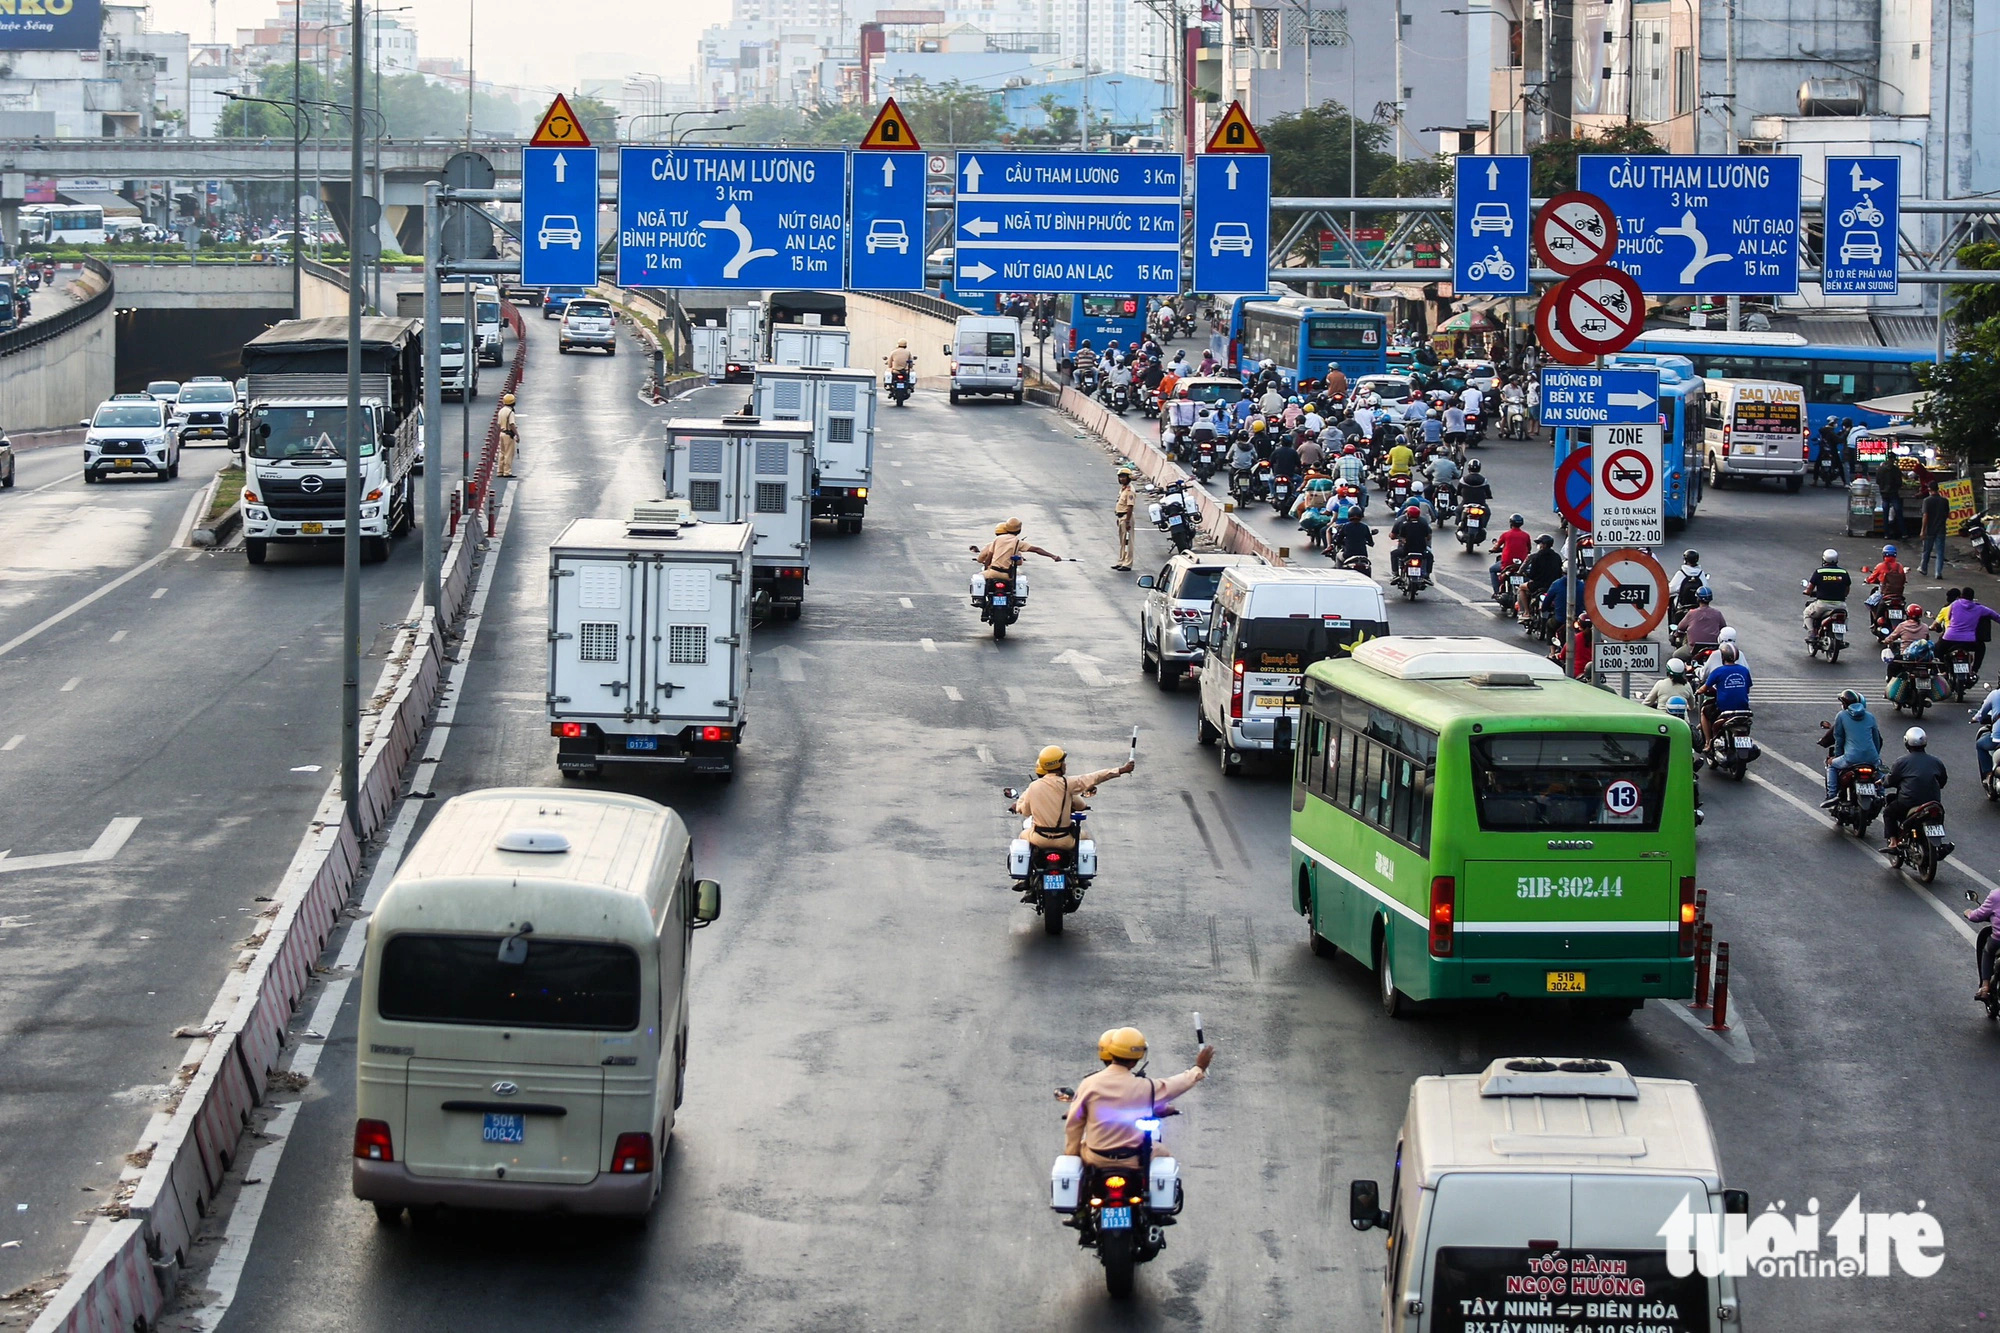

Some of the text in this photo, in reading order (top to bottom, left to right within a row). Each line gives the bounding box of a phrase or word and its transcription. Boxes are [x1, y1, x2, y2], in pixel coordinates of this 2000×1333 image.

[24, 20, 54, 33] Sống
[652, 149, 815, 184] CẦU THAM LƯƠNG
[1005, 160, 1176, 185] CẦU THAM LƯƠNG 3 Km
[1608, 157, 1770, 189] CẦU THAM LƯƠNG
[716, 186, 753, 202] 3 km
[1671, 192, 1708, 208] 3 km
[637, 209, 689, 227] NGÃ TƯ
[778, 210, 842, 231] NÚT GIAO
[1004, 210, 1175, 232] NGÃ TƯ BÌNH PHƯỚC 12 Km
[1626, 217, 1645, 234] TƯ
[1733, 215, 1760, 235] NÚT
[622, 226, 707, 249] BÌNH PHƯỚC
[785, 234, 836, 253] AN LẠC
[1617, 235, 1664, 255] PHƯỚC
[1738, 239, 1788, 258] AN LẠC
[645, 254, 682, 270] 12 km
[791, 256, 828, 272] 15 km
[1622, 260, 1642, 276] km
[1744, 260, 1780, 276] 15 km
[1003, 260, 1174, 282] NÚT GIAO AN LẠC 15 Km
[1828, 268, 1833, 279] Ô
[1834, 268, 1845, 279] TÔ
[1858, 268, 1876, 279] PHẢI
[1878, 268, 1893, 279] VÀO
[1826, 279, 1894, 290] BẾN XE AN SƯƠNG
[1124, 300, 1137, 313] 65
[1364, 332, 1376, 342] 41
[1545, 370, 1602, 388] HƯỚNG ĐI
[1549, 388, 1595, 404] BẾN XE
[1740, 387, 1800, 402] SAO VÀNG
[1545, 406, 1608, 422] AN SƯƠNG
[1608, 428, 1644, 445] ZONE
[1603, 505, 1658, 516] XE Ô TÔ KHÁCH
[1600, 514, 1659, 527] CÓ GIƯỜNG NẰM
[1602, 645, 1621, 656] 6:00
[1629, 644, 1648, 656] 9:00
[1599, 658, 1623, 669] 16:00
[1630, 658, 1655, 669] 20:00
[1609, 787, 1637, 807] 13
[1547, 840, 1594, 850] SAMCO
[1516, 876, 1623, 898] 51B-302.44
[1557, 973, 1575, 982] 51B
[1551, 982, 1581, 991] 302.44
[493, 1114, 515, 1128] 50A
[1105, 1208, 1127, 1218] 59-A1
[1528, 1250, 1627, 1275] TỐC HÀNH
[1506, 1274, 1646, 1300] NGỌC HƯƠNG
[1460, 1297, 1679, 1319] TÂY NINH BIÊN HÒA
[1464, 1319, 1524, 1333] BX.TÂY
